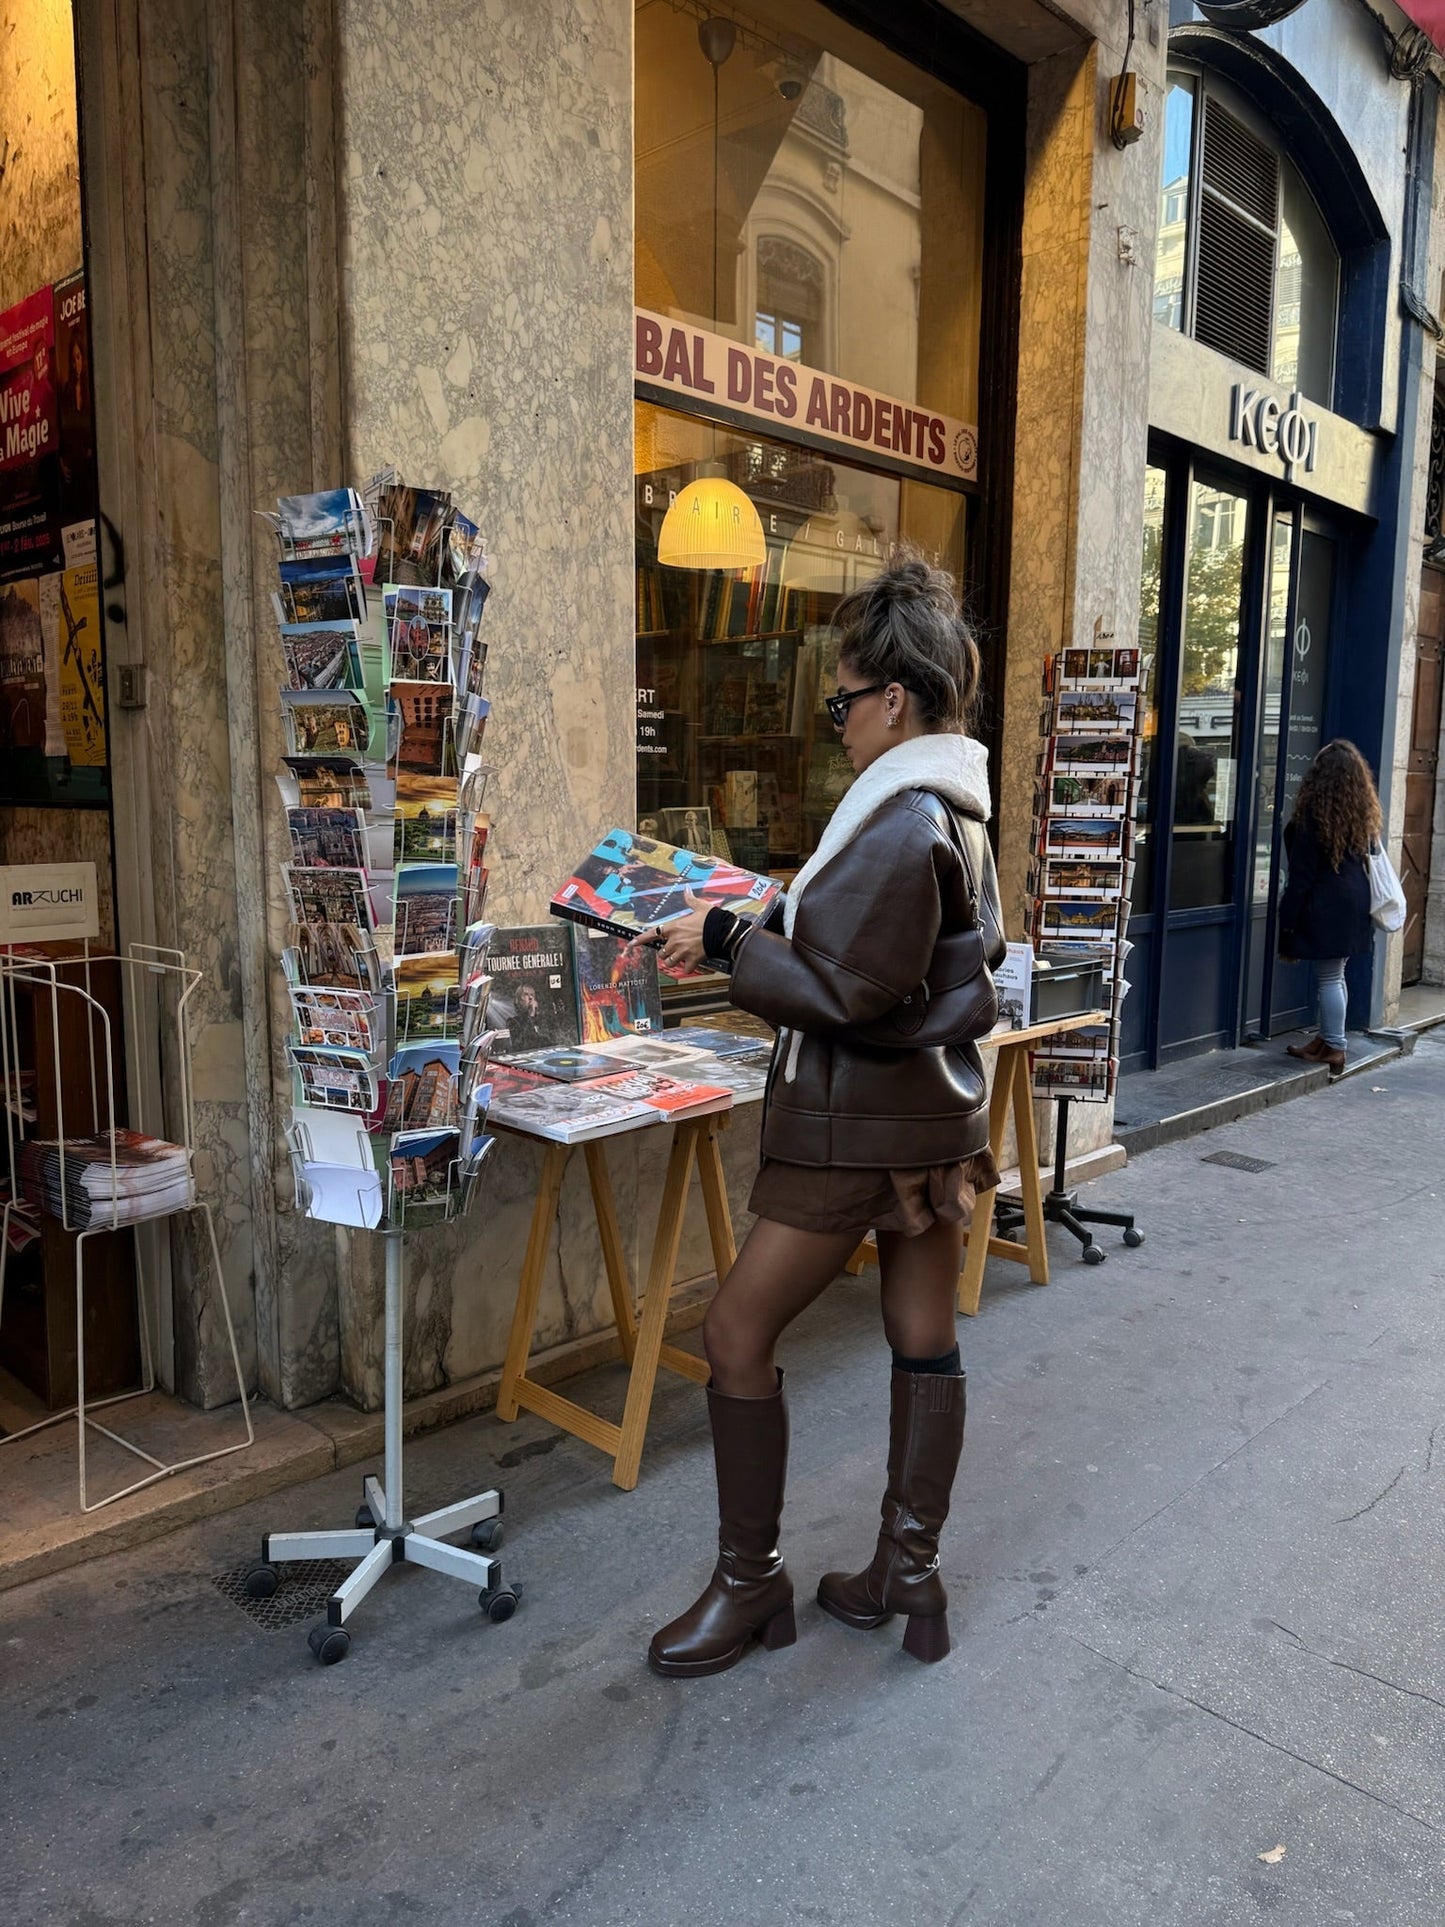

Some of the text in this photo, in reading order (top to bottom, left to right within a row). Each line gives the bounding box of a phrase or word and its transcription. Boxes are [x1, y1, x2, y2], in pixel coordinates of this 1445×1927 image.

[60, 295, 77, 321] JOE
[636, 315, 715, 394] BAL
[728, 347, 798, 413] DES
[806, 377, 946, 465] ARDENTS
[0, 387, 31, 424] Vive
[6, 418, 49, 459] Magie
[636, 688, 655, 704] RT
[638, 709, 664, 719] Samedi
[639, 725, 656, 737] 19h
[487, 954, 521, 972] TOURNÉE
[522, 952, 559, 970] GÉNÉRALE
[589, 982, 618, 991] LORENZO
[636, 1021, 650, 1030] 20€
